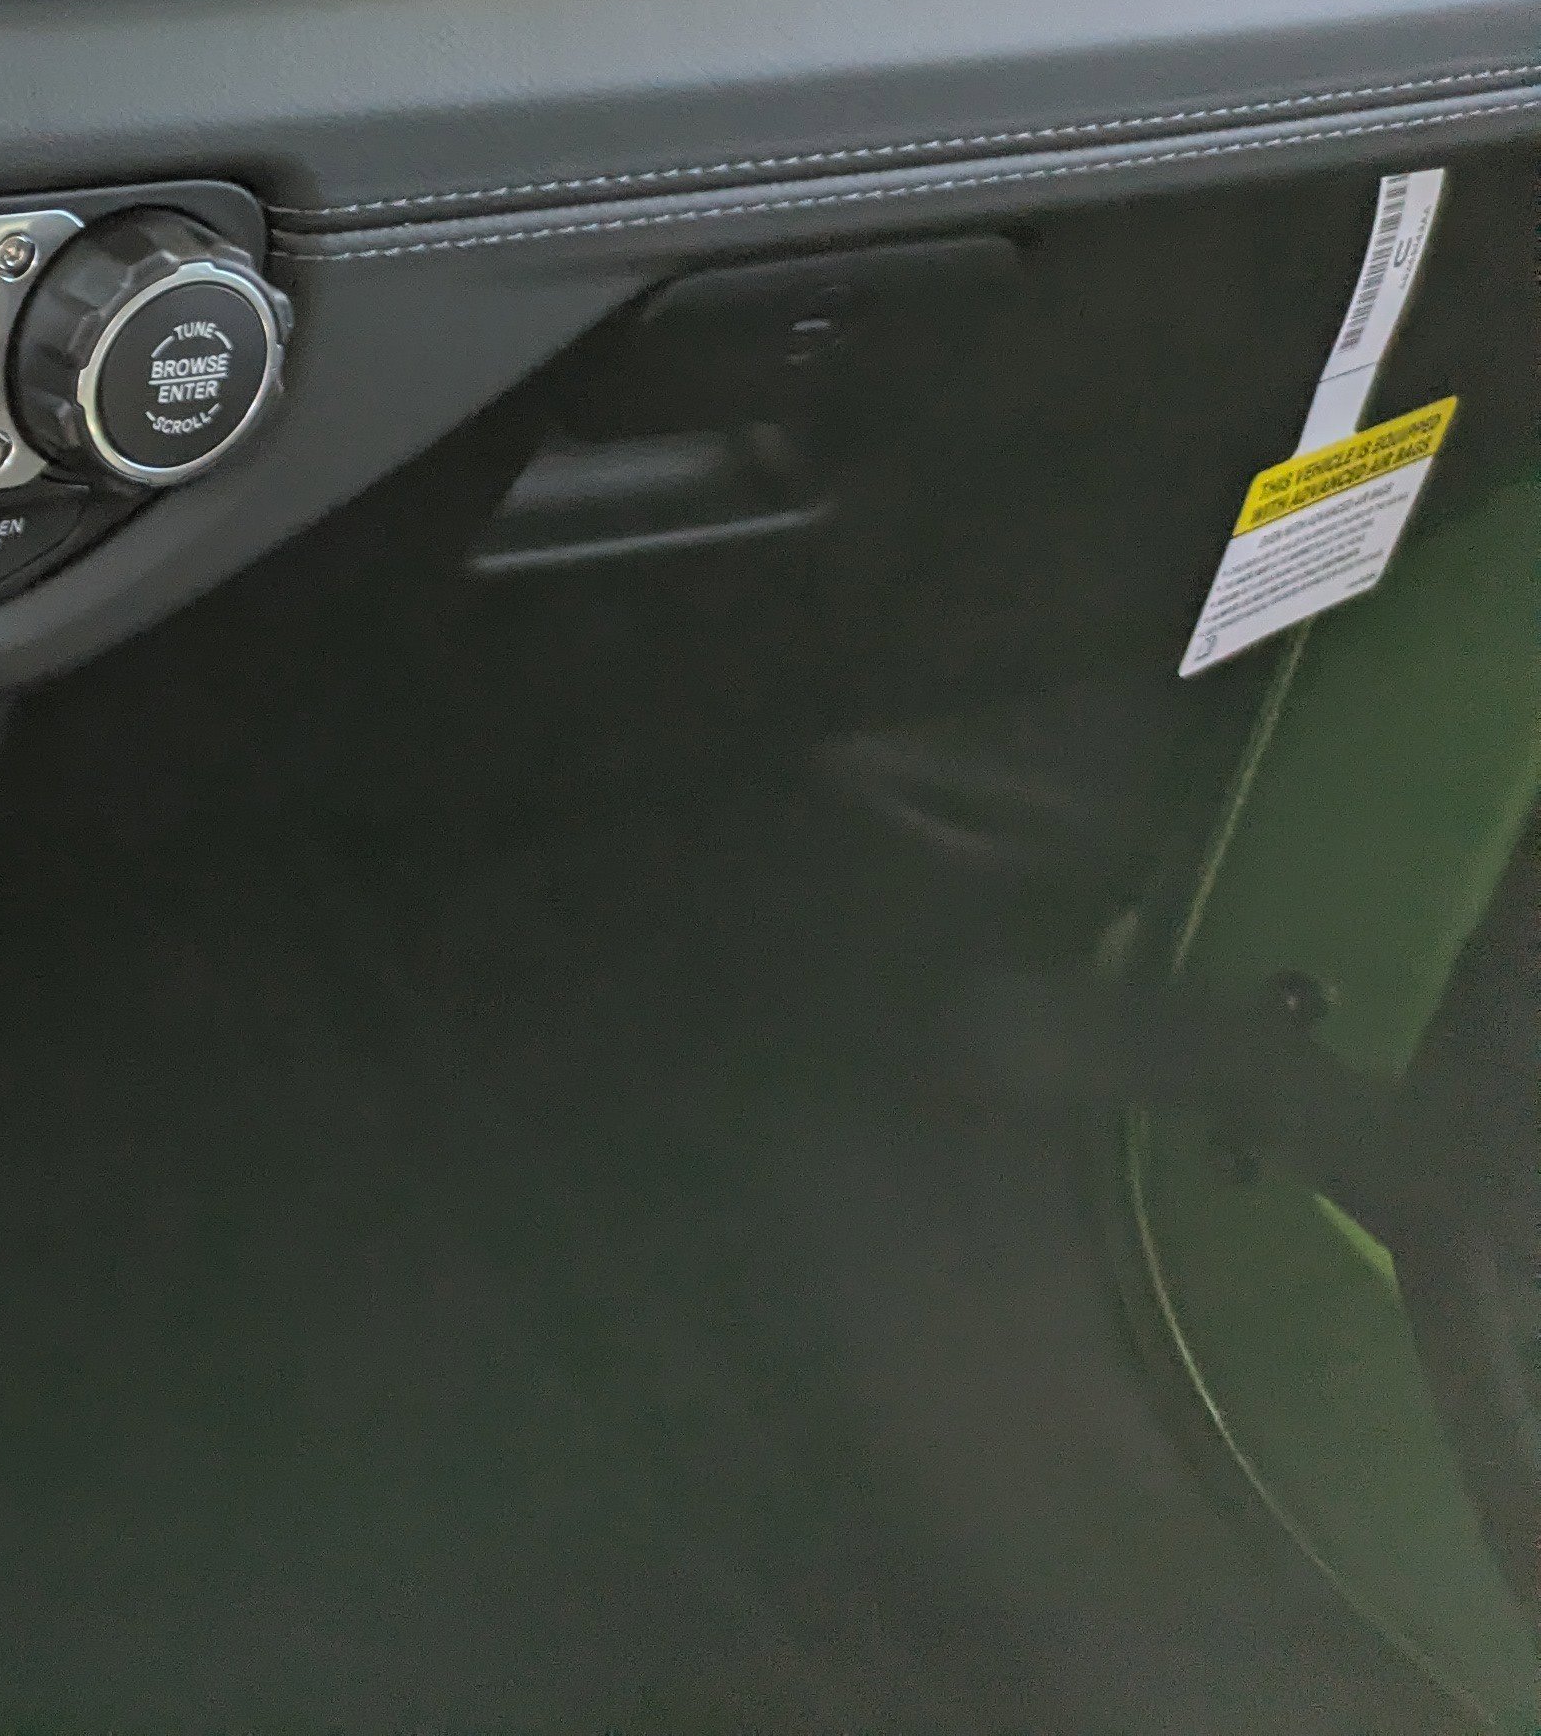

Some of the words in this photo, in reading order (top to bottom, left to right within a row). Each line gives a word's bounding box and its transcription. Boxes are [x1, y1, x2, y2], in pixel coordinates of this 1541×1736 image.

[174, 321, 217, 341] TUNE
[151, 353, 231, 379] BROWSE
[158, 380, 218, 404] ENTER
[152, 412, 212, 434] SCROLL
